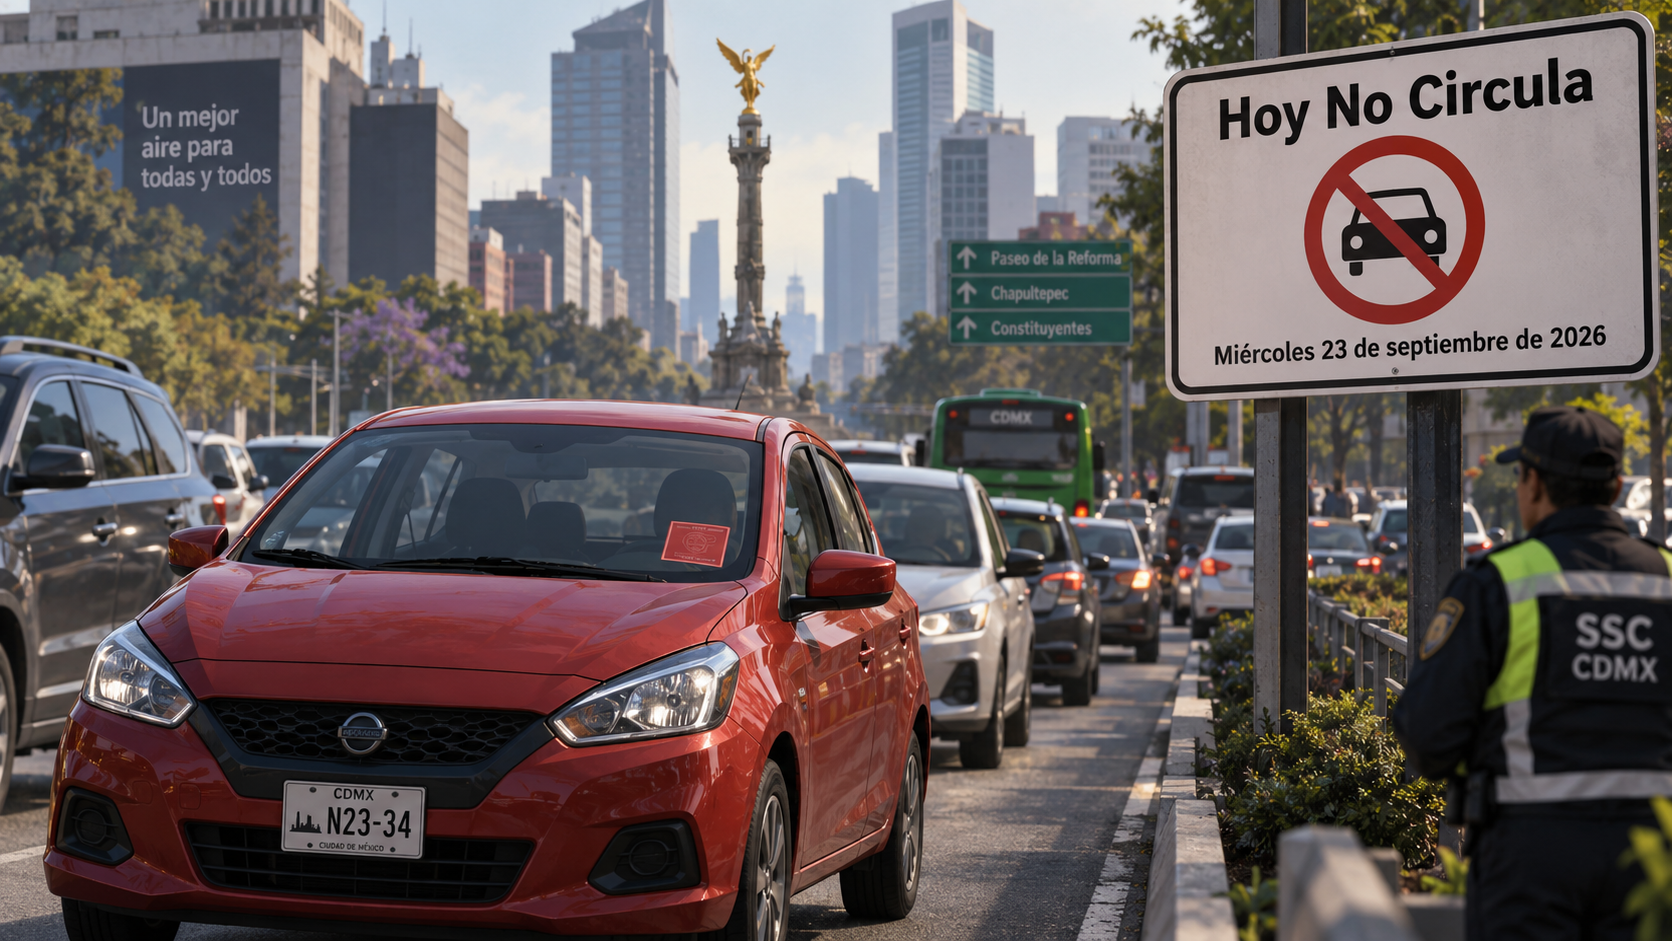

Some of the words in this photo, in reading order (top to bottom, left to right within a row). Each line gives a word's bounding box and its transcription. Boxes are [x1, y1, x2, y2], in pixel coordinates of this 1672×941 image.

[1219, 96, 1310, 146] Hoy
[1327, 83, 1393, 129] No
[1409, 57, 1593, 120] Circula
[142, 106, 172, 129] Un
[178, 103, 239, 132] mejor
[141, 135, 181, 158] aire
[187, 138, 233, 163] para
[141, 165, 196, 188] todas
[200, 170, 213, 192] y
[217, 162, 272, 185] todos
[991, 251, 1030, 265] Paseo
[1033, 250, 1049, 265] de
[1052, 250, 1064, 265] la
[1068, 250, 1122, 265] Reforma
[991, 285, 1069, 304] Chapultepec
[991, 320, 1092, 339] Constituyentes
[1214, 341, 1315, 366] Miércoles
[1321, 339, 1348, 360] 23
[1354, 337, 1380, 358] de
[1386, 331, 1509, 361] septiembre
[1515, 328, 1543, 349] de
[1550, 325, 1607, 348] 2026
[990, 410, 1032, 424] CDMX
[1576, 612, 1653, 651] SSC
[1571, 653, 1659, 683] CDMX
[333, 787, 374, 801] CDMX
[327, 806, 411, 839] N23-34
